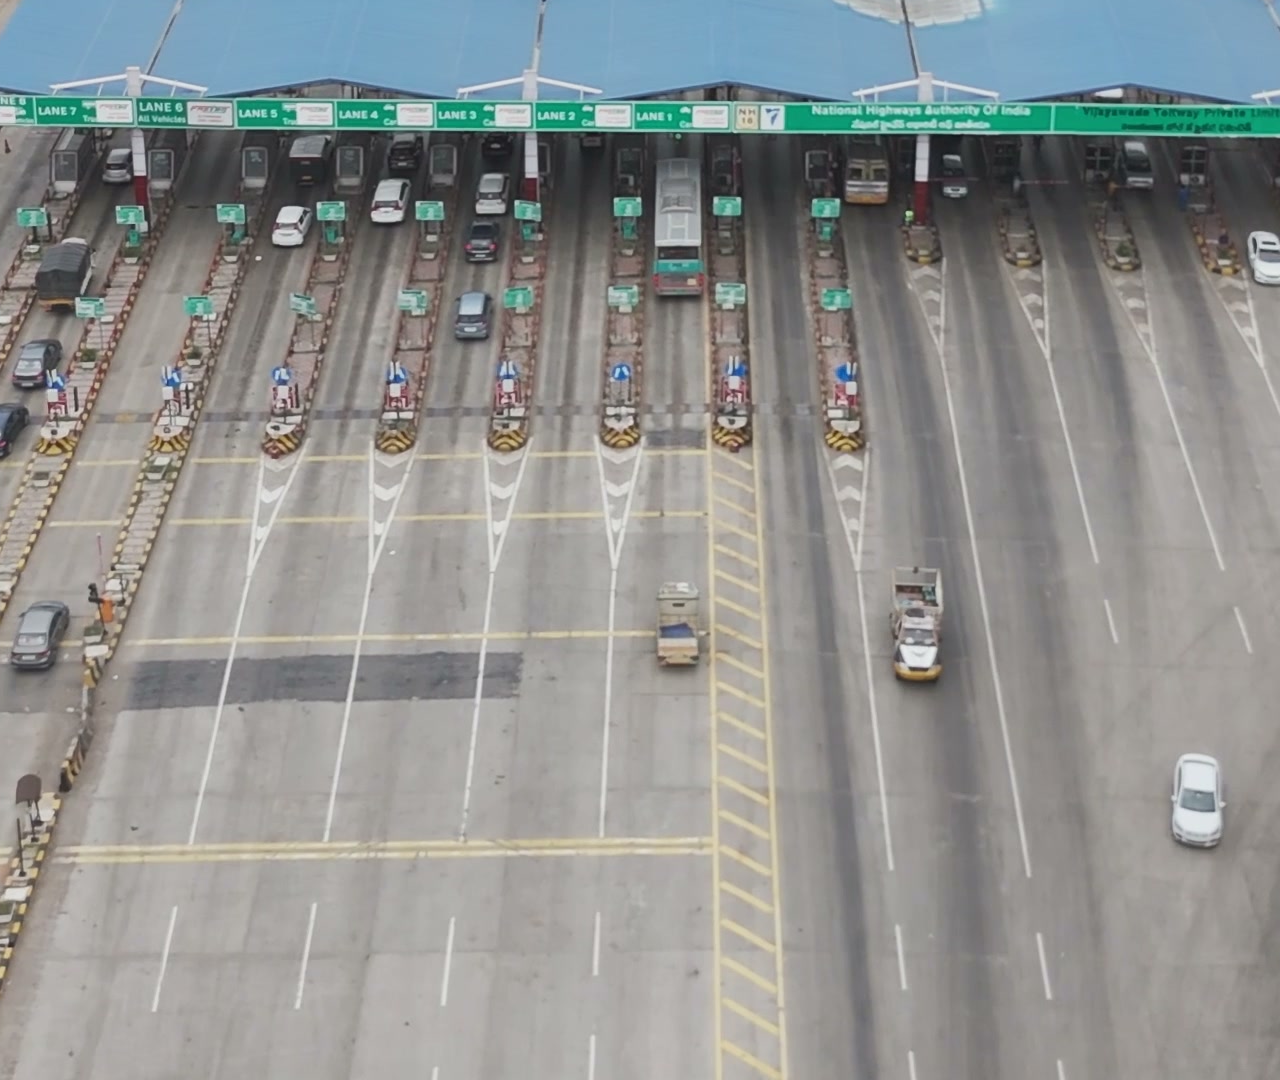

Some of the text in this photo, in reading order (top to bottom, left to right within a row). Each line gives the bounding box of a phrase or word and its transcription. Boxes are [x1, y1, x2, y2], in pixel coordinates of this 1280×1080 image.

[38, 106, 77, 116] LANE 7
[139, 102, 172, 112] LANE
[175, 102, 183, 112] 6
[811, 105, 1031, 118] National Highways Authority Of India
[238, 109, 278, 118] LANE 5
[339, 110, 378, 120] LANE 4
[438, 110, 468, 120] LANE
[469, 111, 477, 120] 3
[537, 111, 566, 120] LANE
[568, 112, 576, 120] 2
[636, 112, 666, 121] LANE
[667, 113, 672, 122] 1
[1083, 107, 1150, 119] Vijayawada
[1204, 108, 1246, 118] Private
[151, 115, 186, 124] Vehicles
[282, 117, 297, 125] Tru
